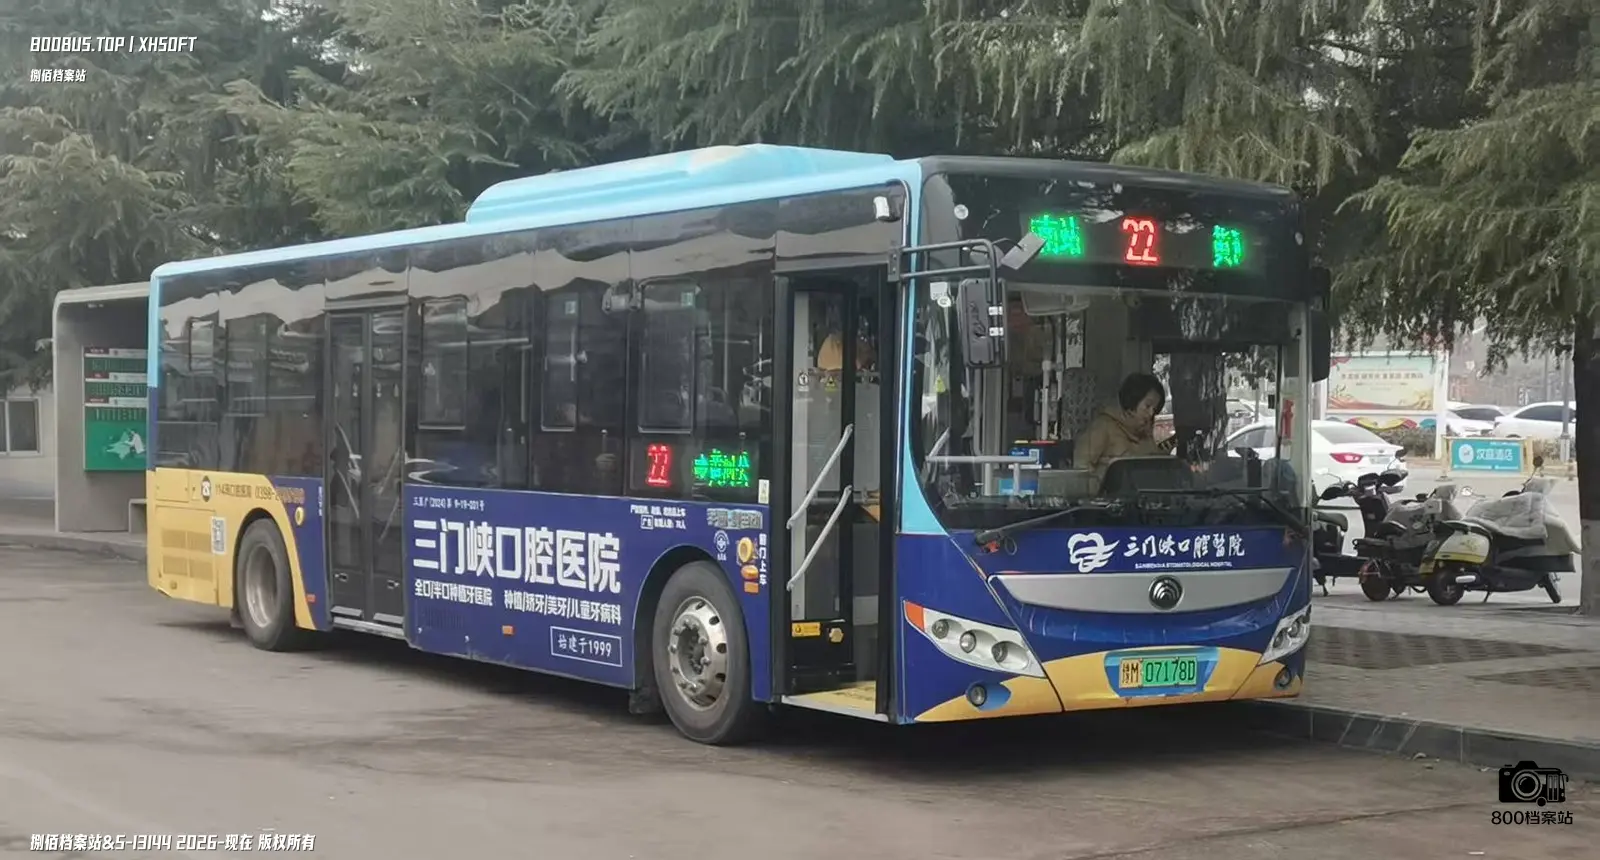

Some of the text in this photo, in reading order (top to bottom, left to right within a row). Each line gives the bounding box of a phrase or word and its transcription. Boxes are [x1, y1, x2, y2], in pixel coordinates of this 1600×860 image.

[1122, 218, 1158, 264] 22
[647, 445, 669, 485] 22
[413, 518, 621, 594] 三门峡口腔医院
[557, 633, 612, 658] 始建于1999
